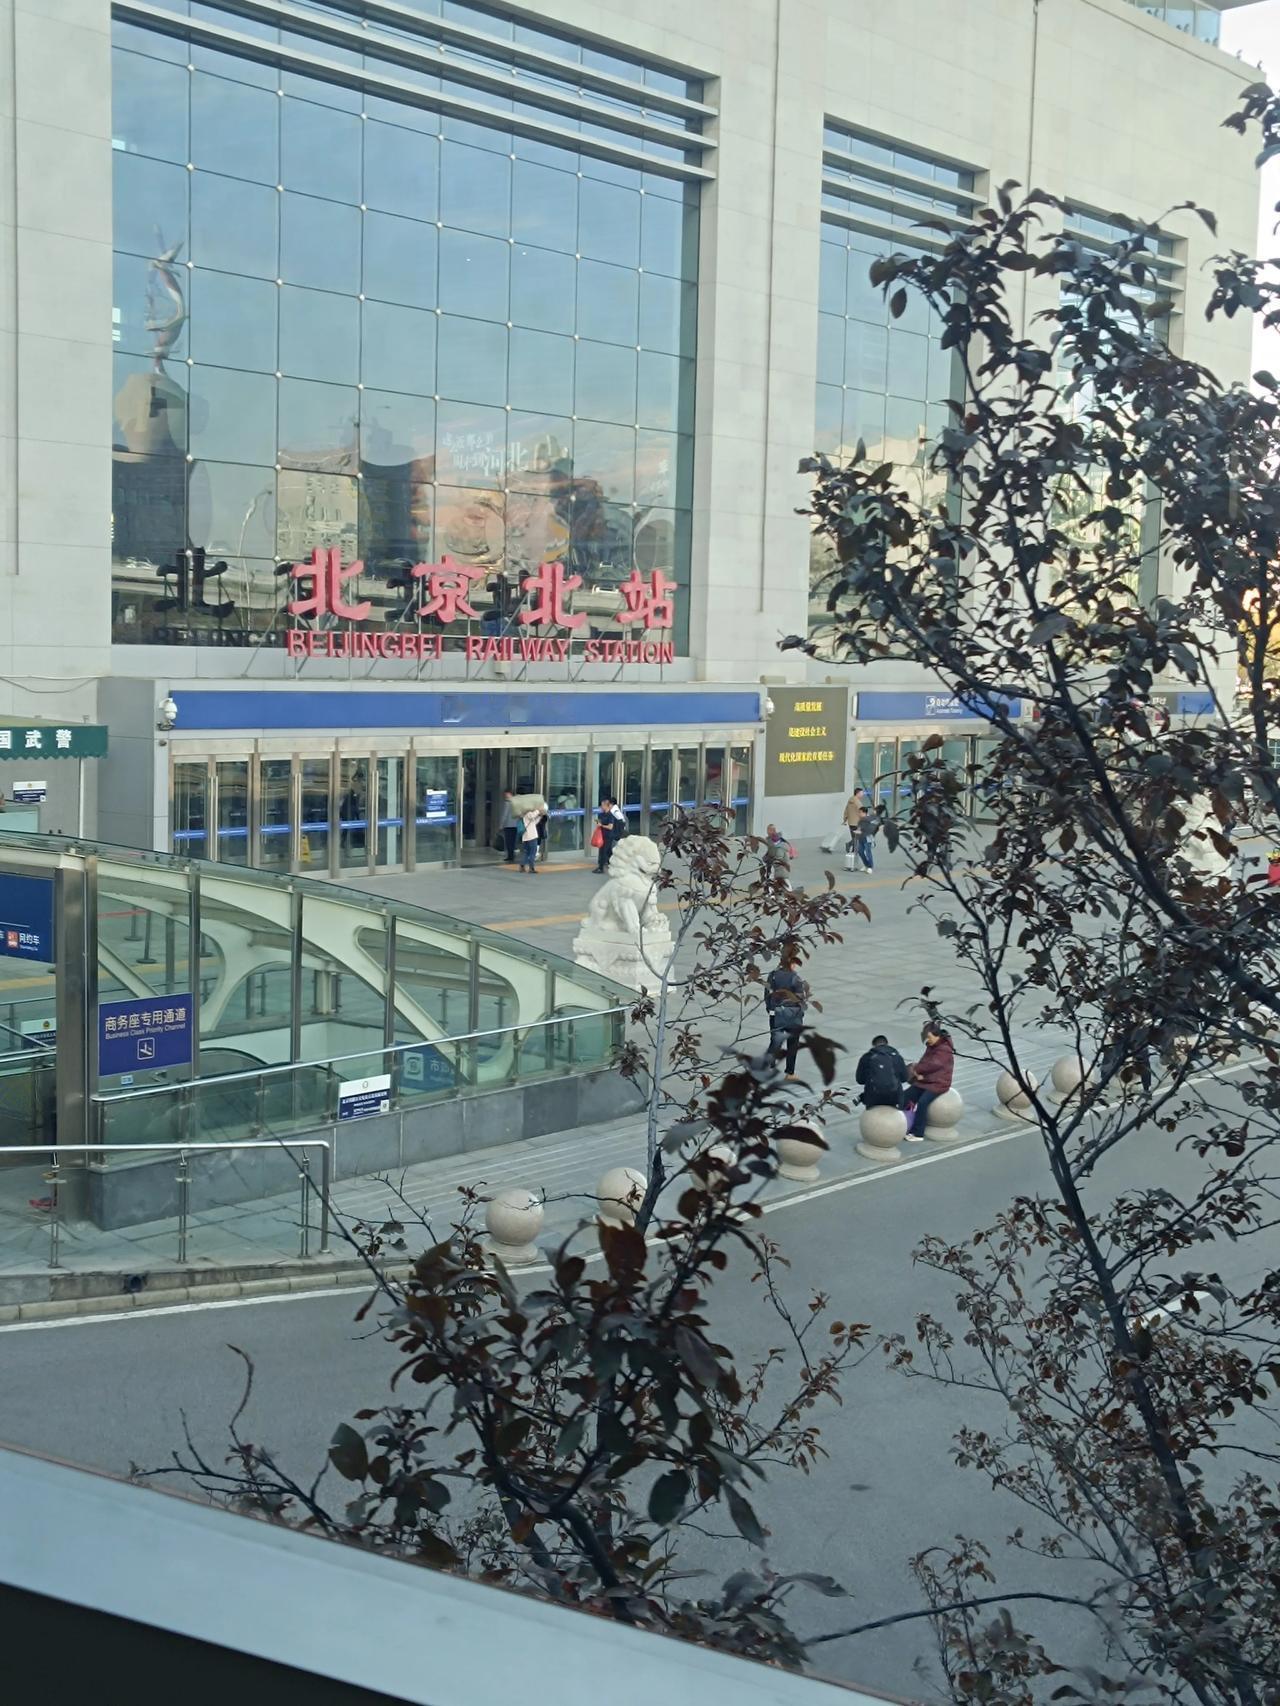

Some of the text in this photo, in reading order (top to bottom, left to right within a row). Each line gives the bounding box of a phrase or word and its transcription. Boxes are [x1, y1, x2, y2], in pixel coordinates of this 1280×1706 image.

[288, 545, 678, 629] 北京北站
[286, 629, 442, 660] BEIJINGBEI
[466, 635, 570, 663] RAILWAY
[584, 639, 674, 665] STATION
[105, 1007, 186, 1031] 商务座专用通道
[105, 1031, 129, 1040] Business
[164, 1022, 186, 1032] Channel
